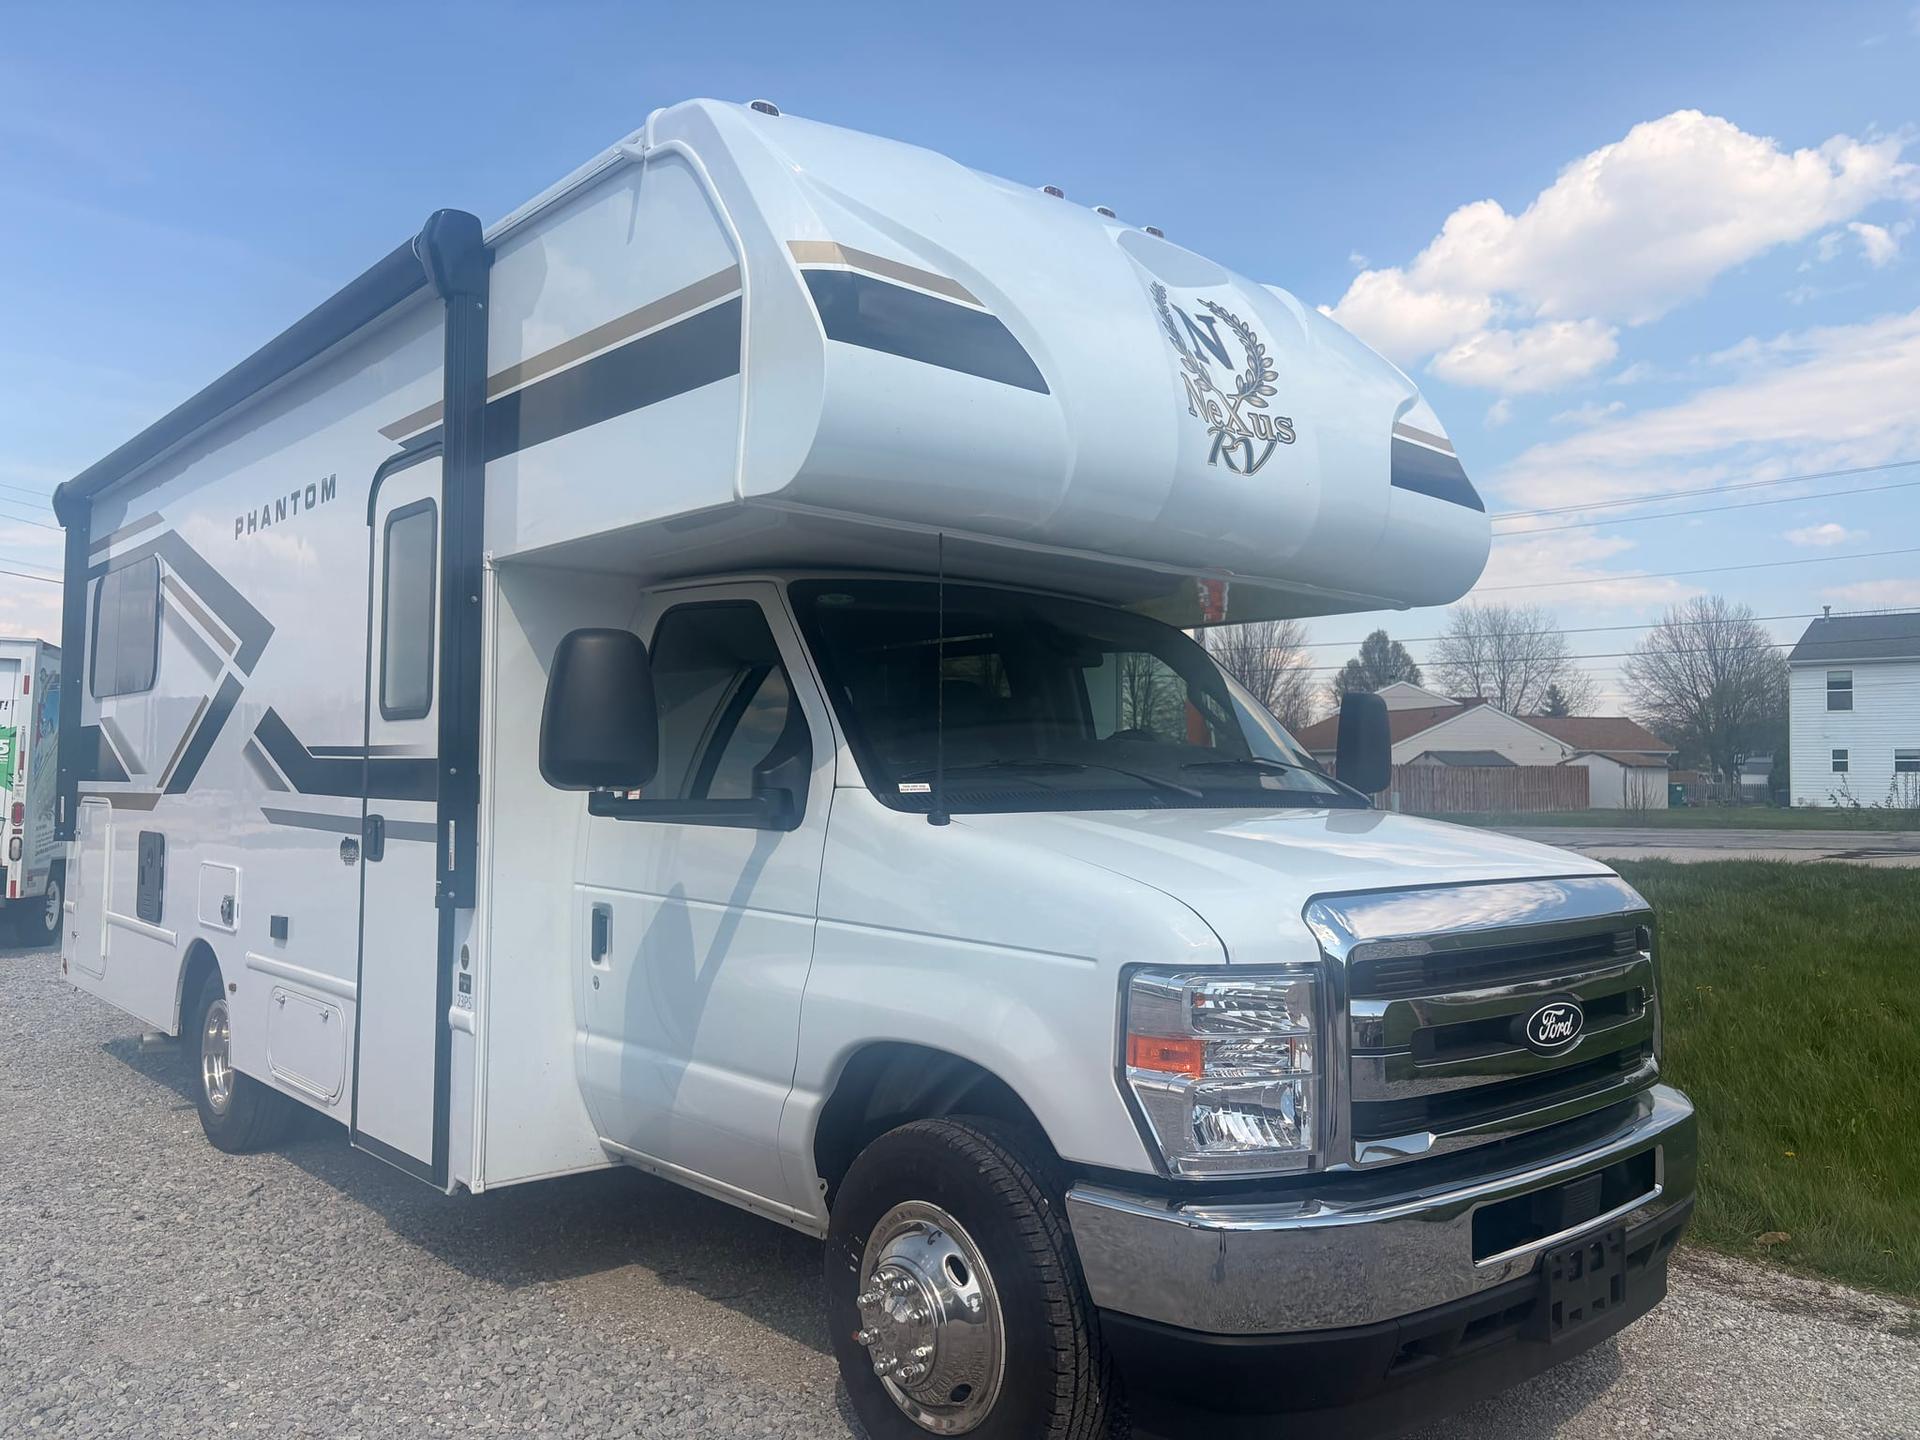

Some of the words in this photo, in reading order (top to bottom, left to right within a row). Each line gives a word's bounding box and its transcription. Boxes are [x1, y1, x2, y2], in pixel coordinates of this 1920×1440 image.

[1170, 303, 1235, 370] N
[1207, 425, 1278, 476] RV
[234, 473, 337, 541] PHANTOM
[1538, 1008, 1574, 1041] Ford
